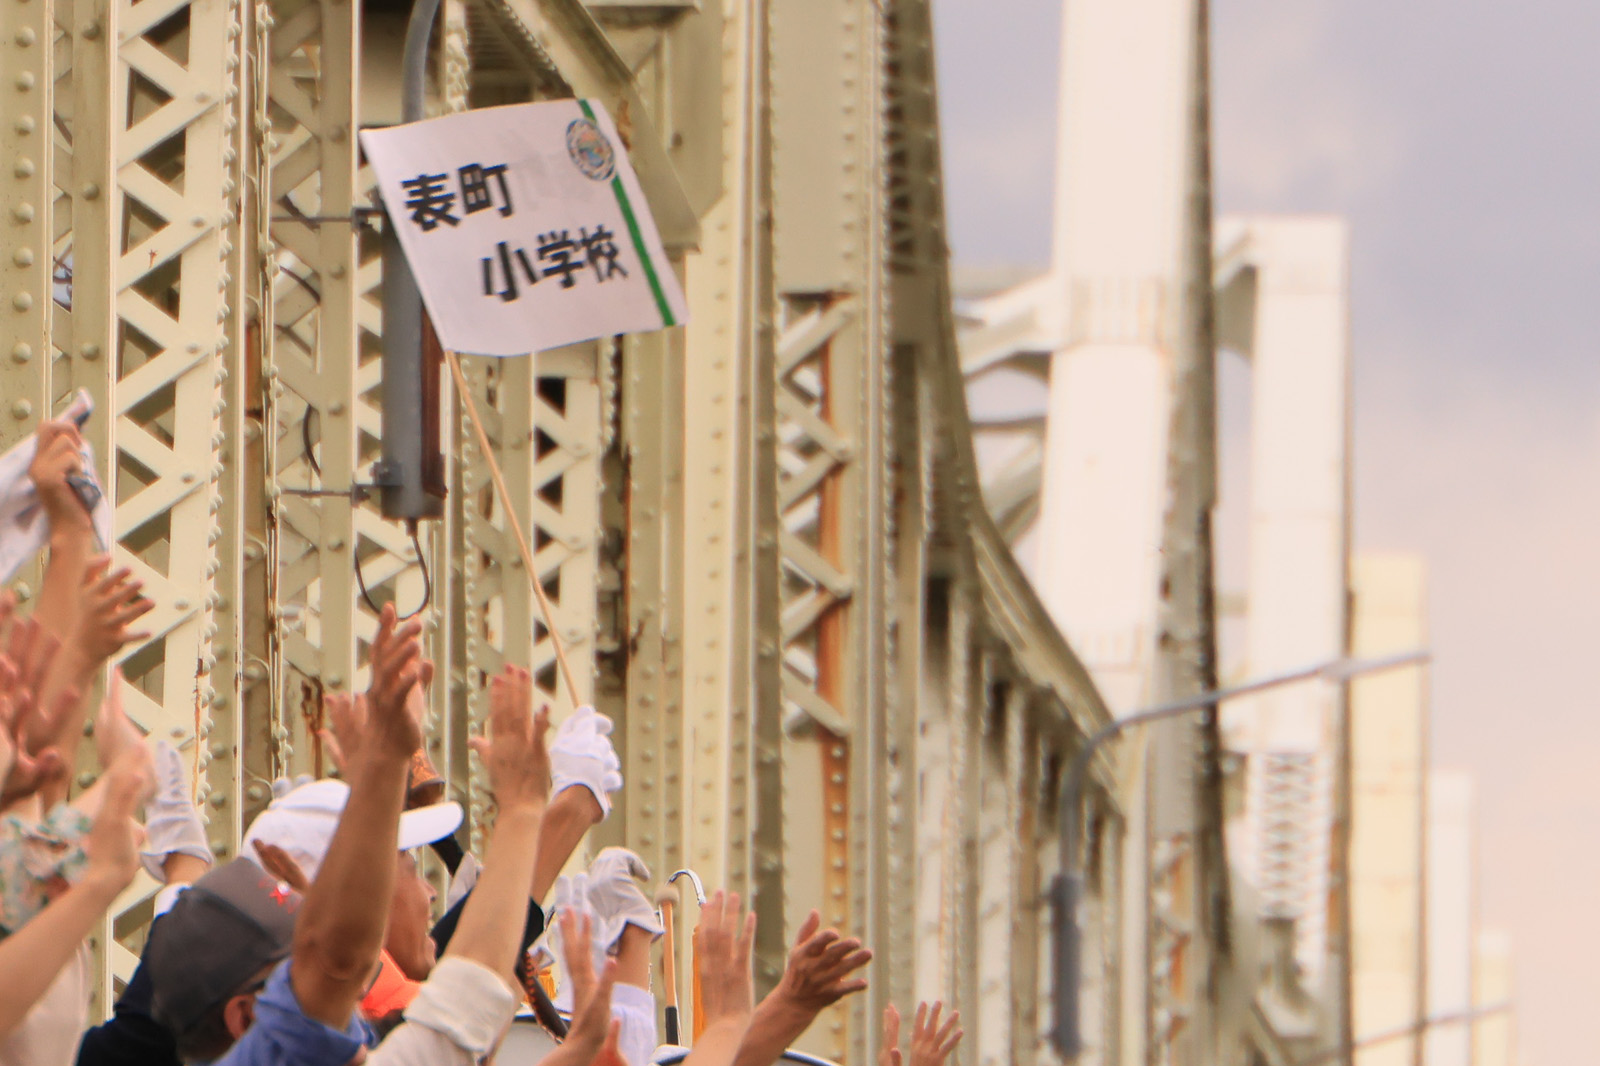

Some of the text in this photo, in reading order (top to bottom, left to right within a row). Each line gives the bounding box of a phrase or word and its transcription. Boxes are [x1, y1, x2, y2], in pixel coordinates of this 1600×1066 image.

[400, 163, 513, 232] 表町
[480, 224, 629, 302] 小学校
